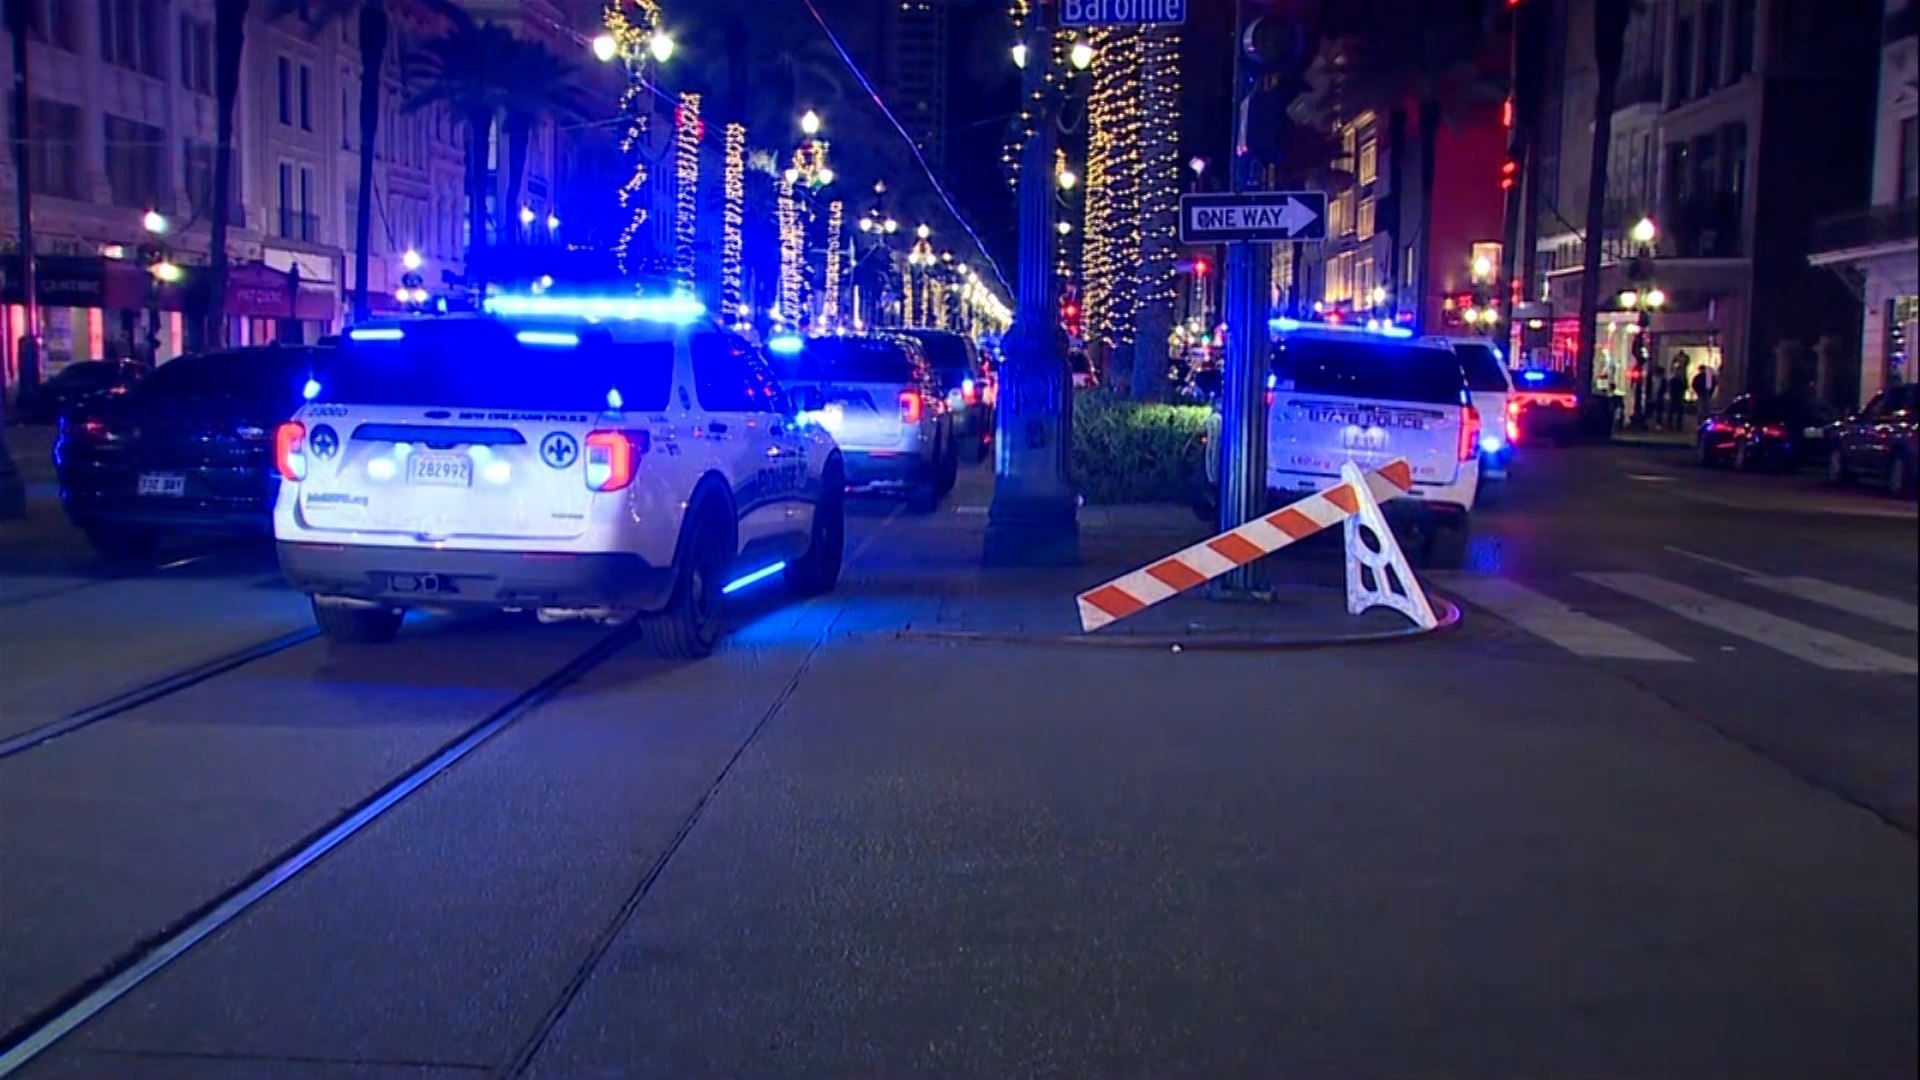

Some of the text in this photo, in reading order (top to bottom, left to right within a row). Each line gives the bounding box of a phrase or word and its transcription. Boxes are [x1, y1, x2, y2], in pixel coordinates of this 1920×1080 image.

[1066, 0, 1181, 20] Baronne
[1197, 208, 1283, 227] ONE WAY
